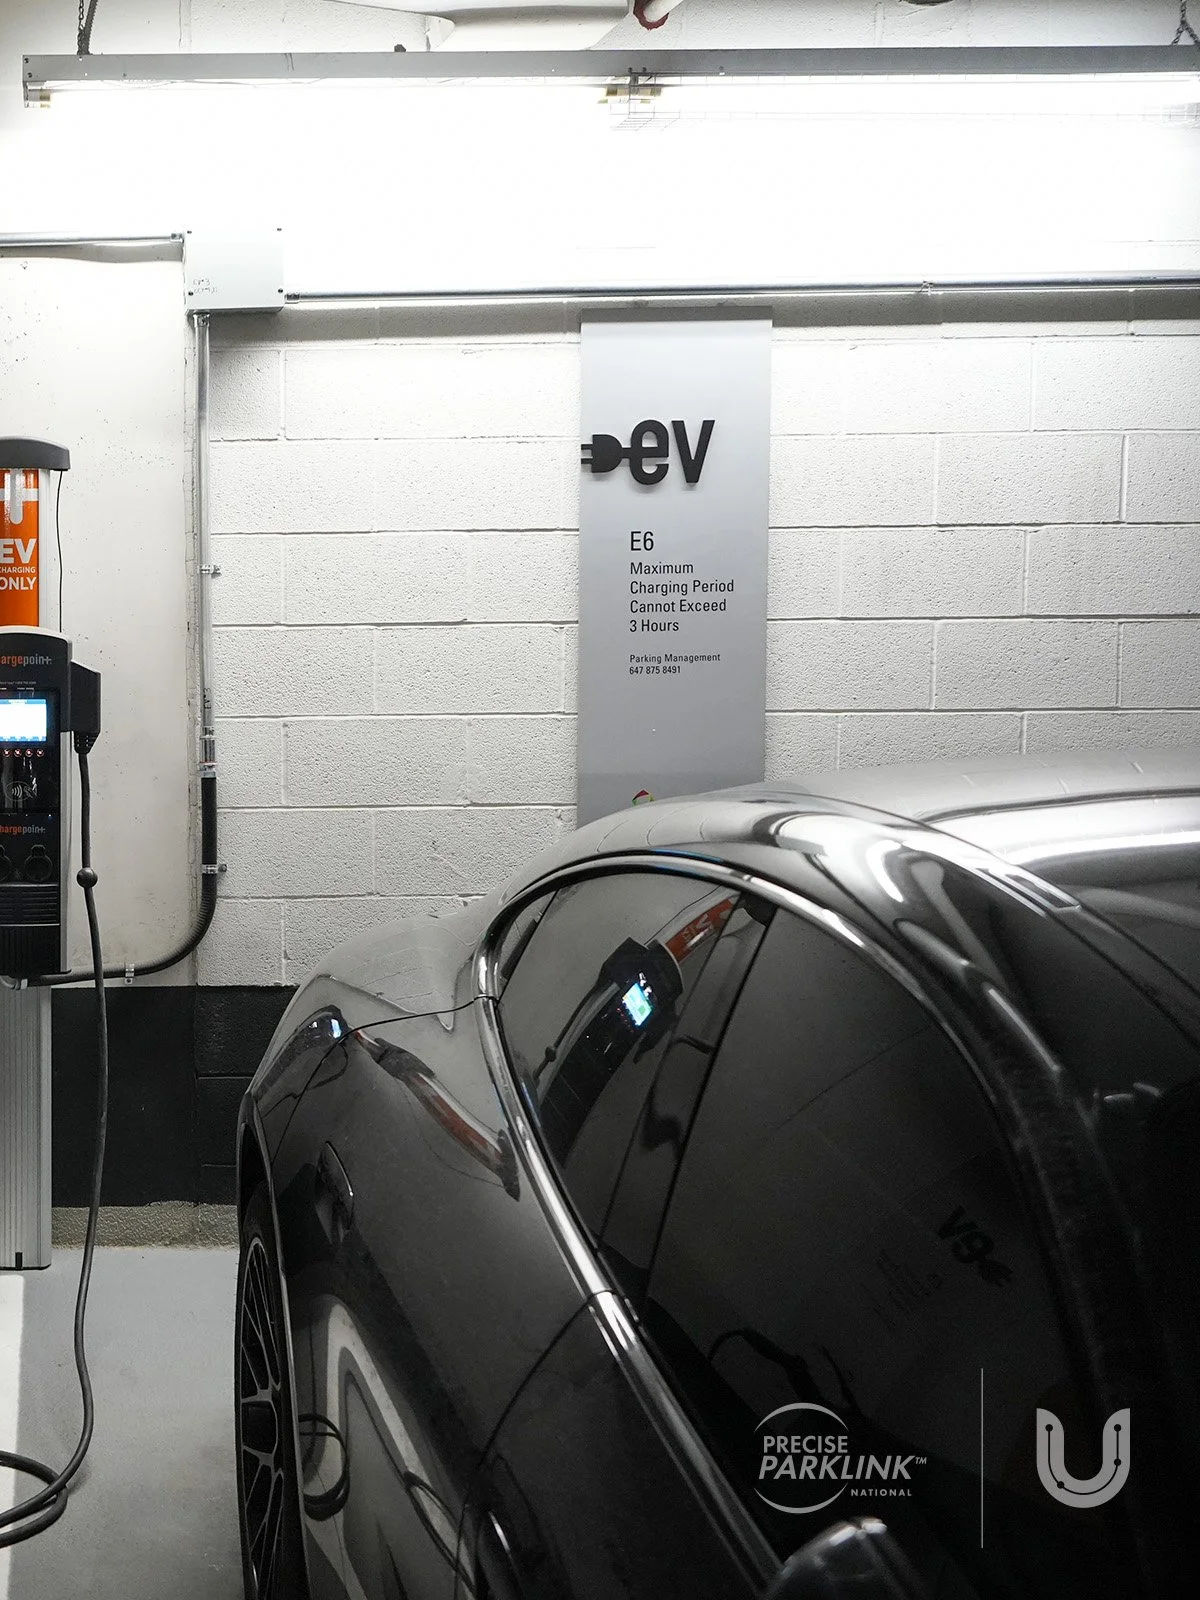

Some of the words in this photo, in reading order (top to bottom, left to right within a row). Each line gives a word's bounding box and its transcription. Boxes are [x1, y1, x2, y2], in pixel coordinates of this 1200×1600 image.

[629, 419, 716, 486] ev
[630, 530, 655, 552] E6
[630, 561, 694, 575] Maximum
[630, 580, 688, 597] Charging
[692, 578, 734, 593] Period
[630, 599, 676, 614] Cannot
[679, 598, 727, 613] Exceed
[629, 619, 638, 633] 3
[641, 618, 680, 632] Hours
[629, 654, 662, 665] Parking
[664, 653, 721, 664] Management
[629, 665, 644, 675] 647
[645, 665, 661, 675] 875
[662, 665, 681, 675] 8491
